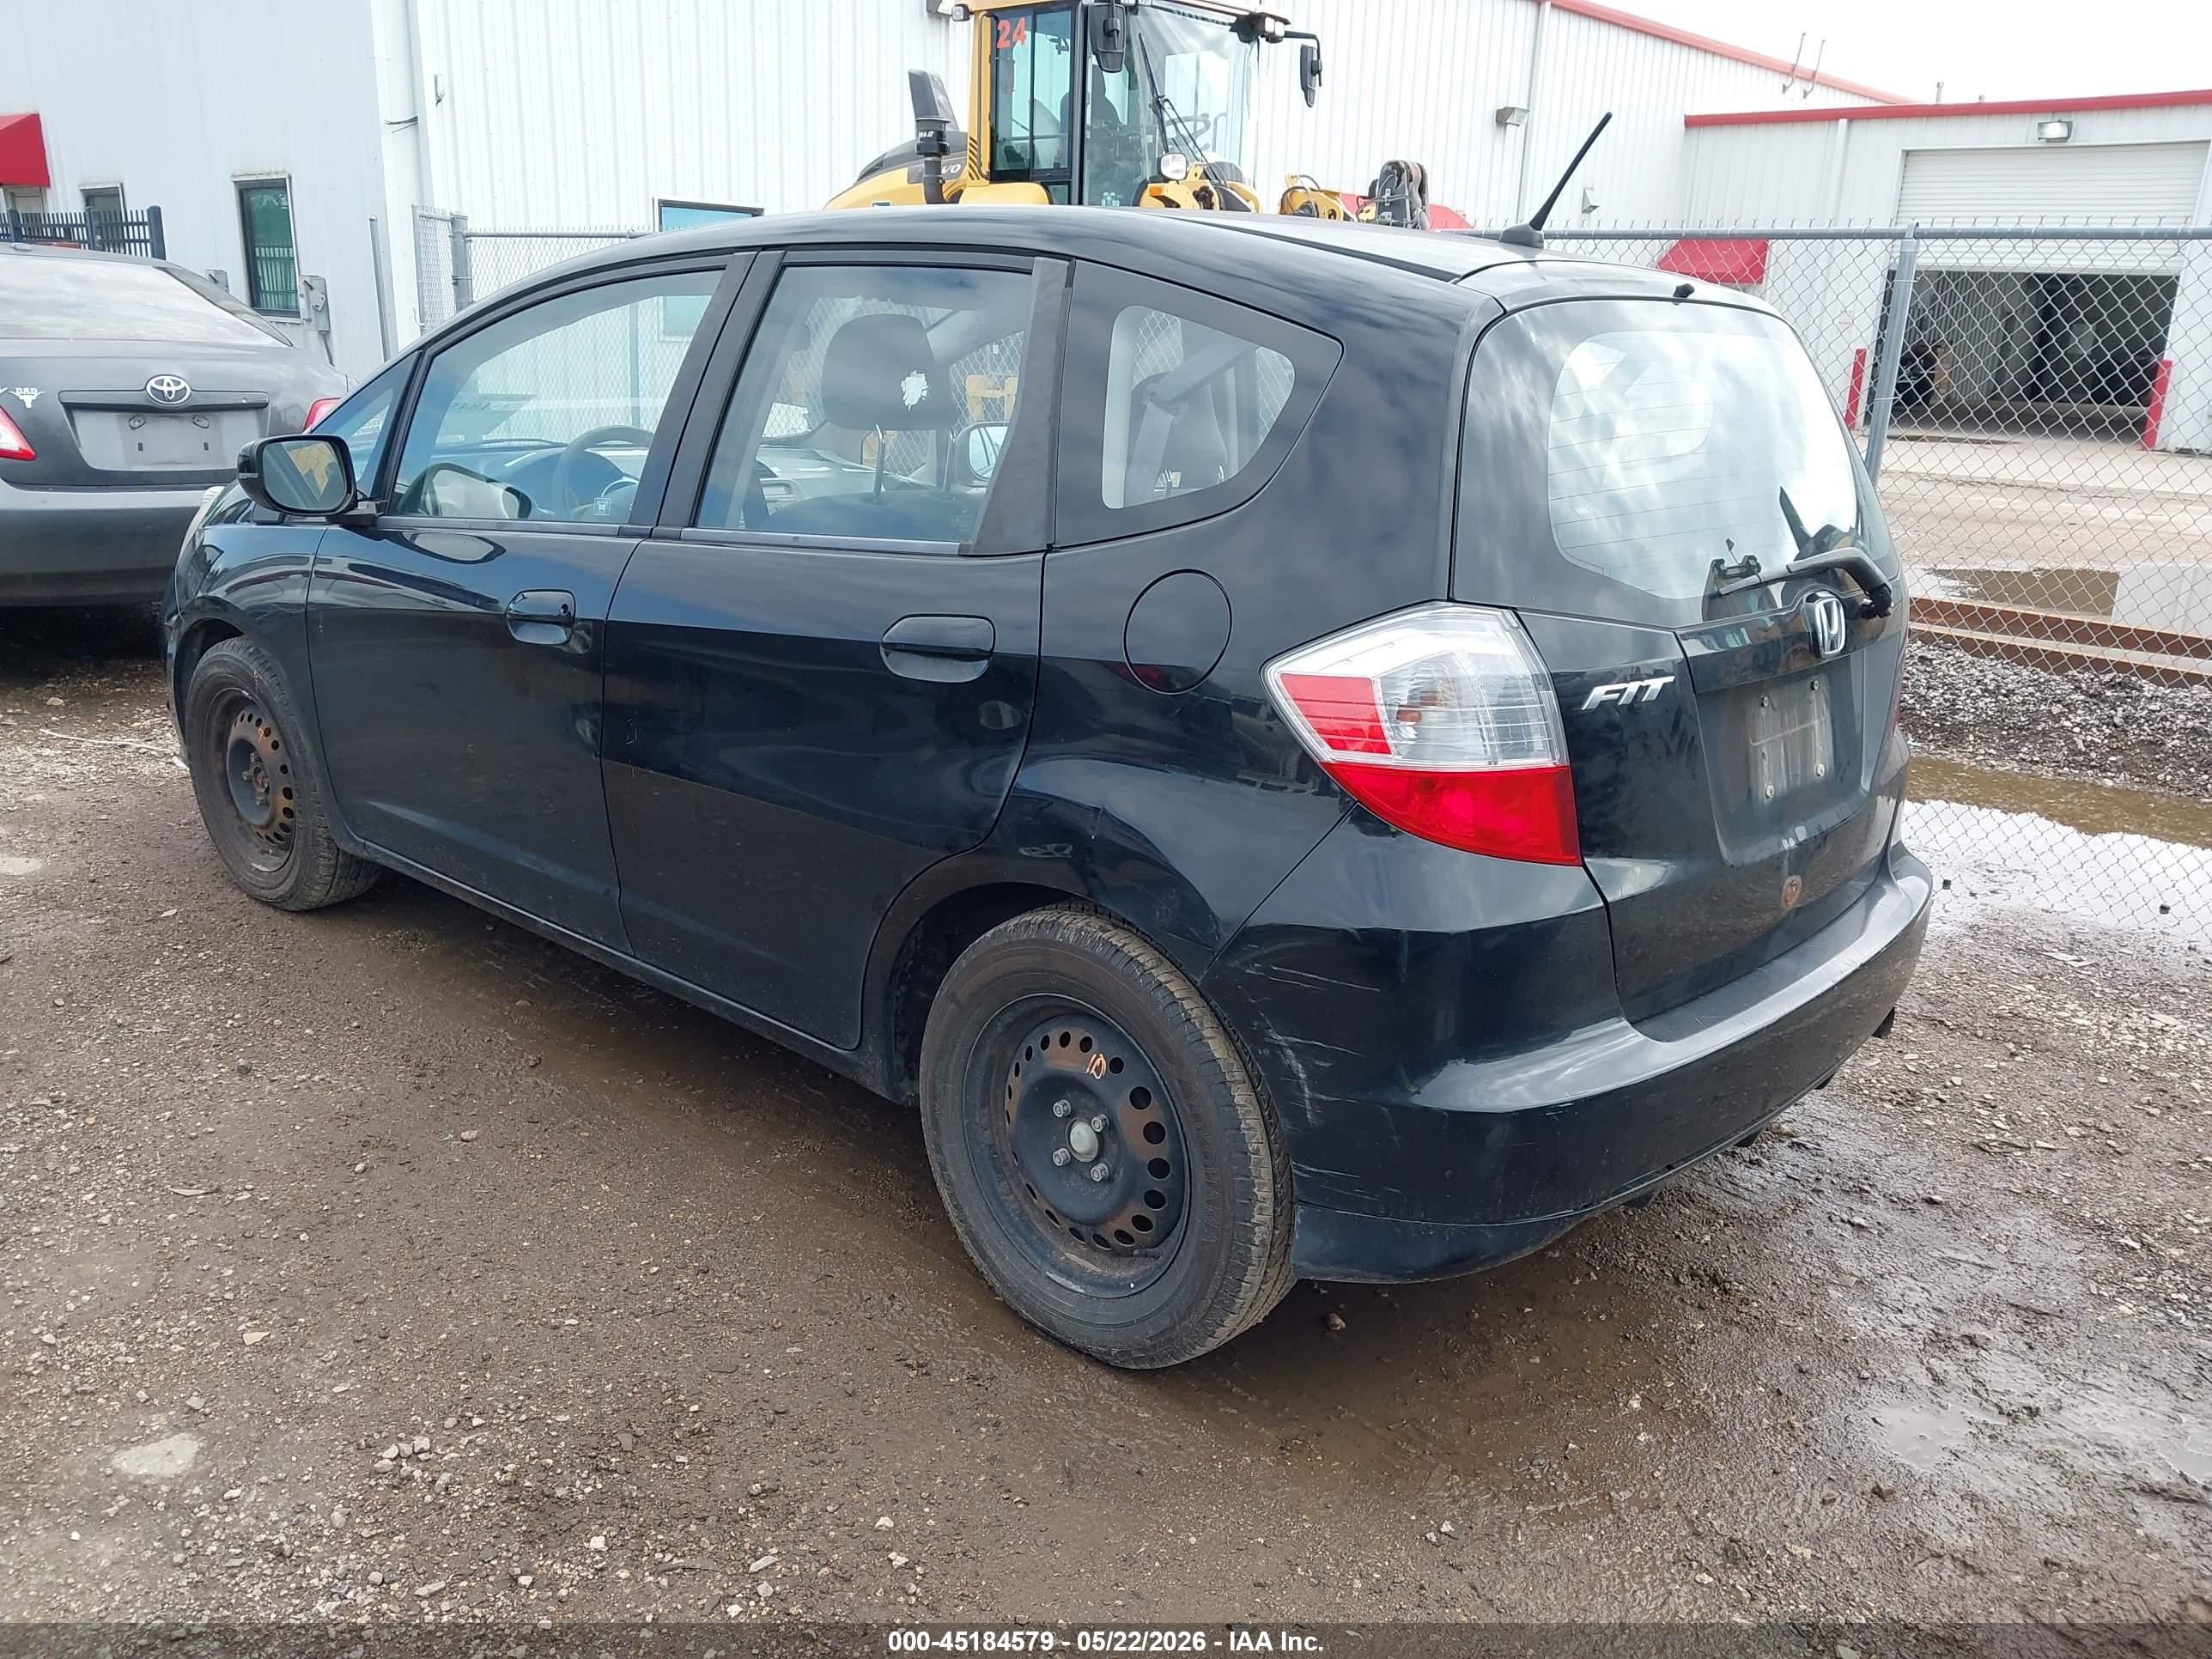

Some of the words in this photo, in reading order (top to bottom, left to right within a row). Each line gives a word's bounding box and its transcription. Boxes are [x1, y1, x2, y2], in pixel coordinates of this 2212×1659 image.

[997, 16, 1026, 49] 24
[1581, 676, 1675, 711] FIT
[1188, 1091, 1221, 1244] YOKOHAMA
